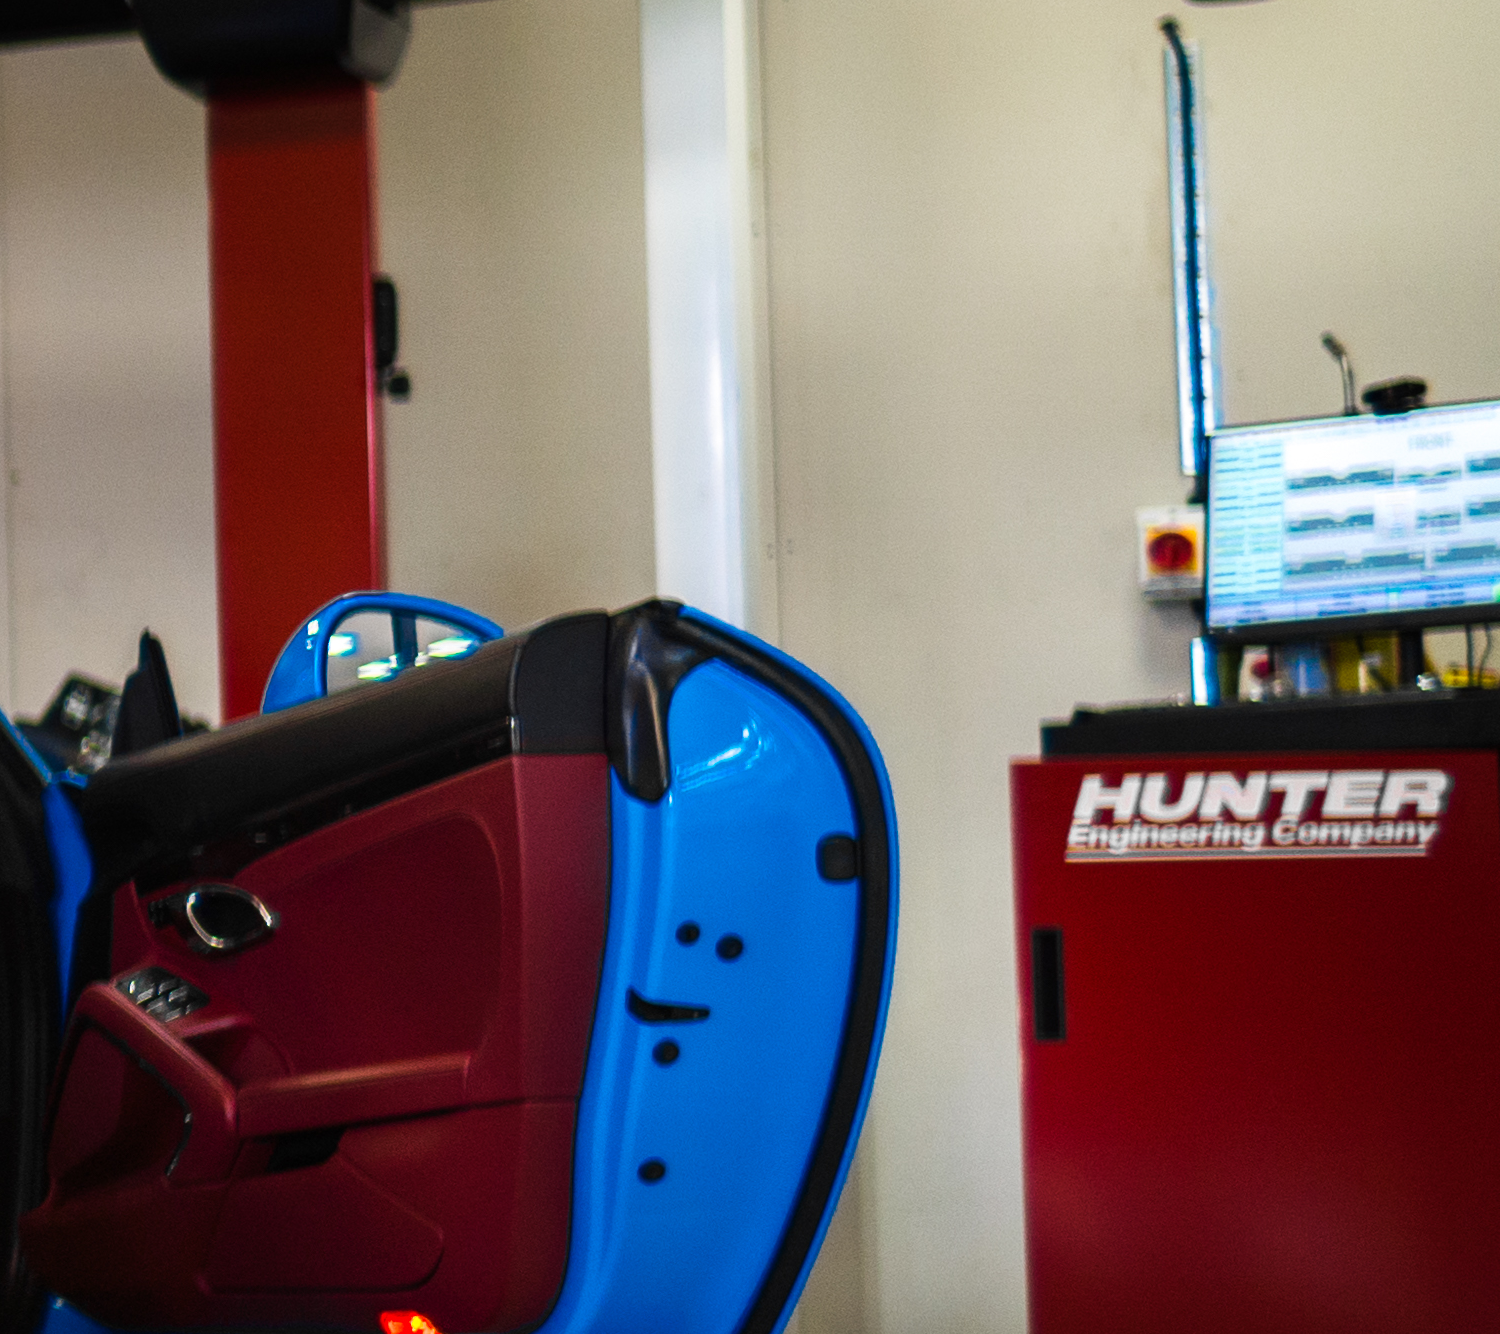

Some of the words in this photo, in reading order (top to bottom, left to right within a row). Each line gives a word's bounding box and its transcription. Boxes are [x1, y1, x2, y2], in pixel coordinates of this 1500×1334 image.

[1072, 769, 1455, 824] HUNTER
[1067, 818, 1266, 855] Engineering
[1271, 816, 1441, 849] Company
